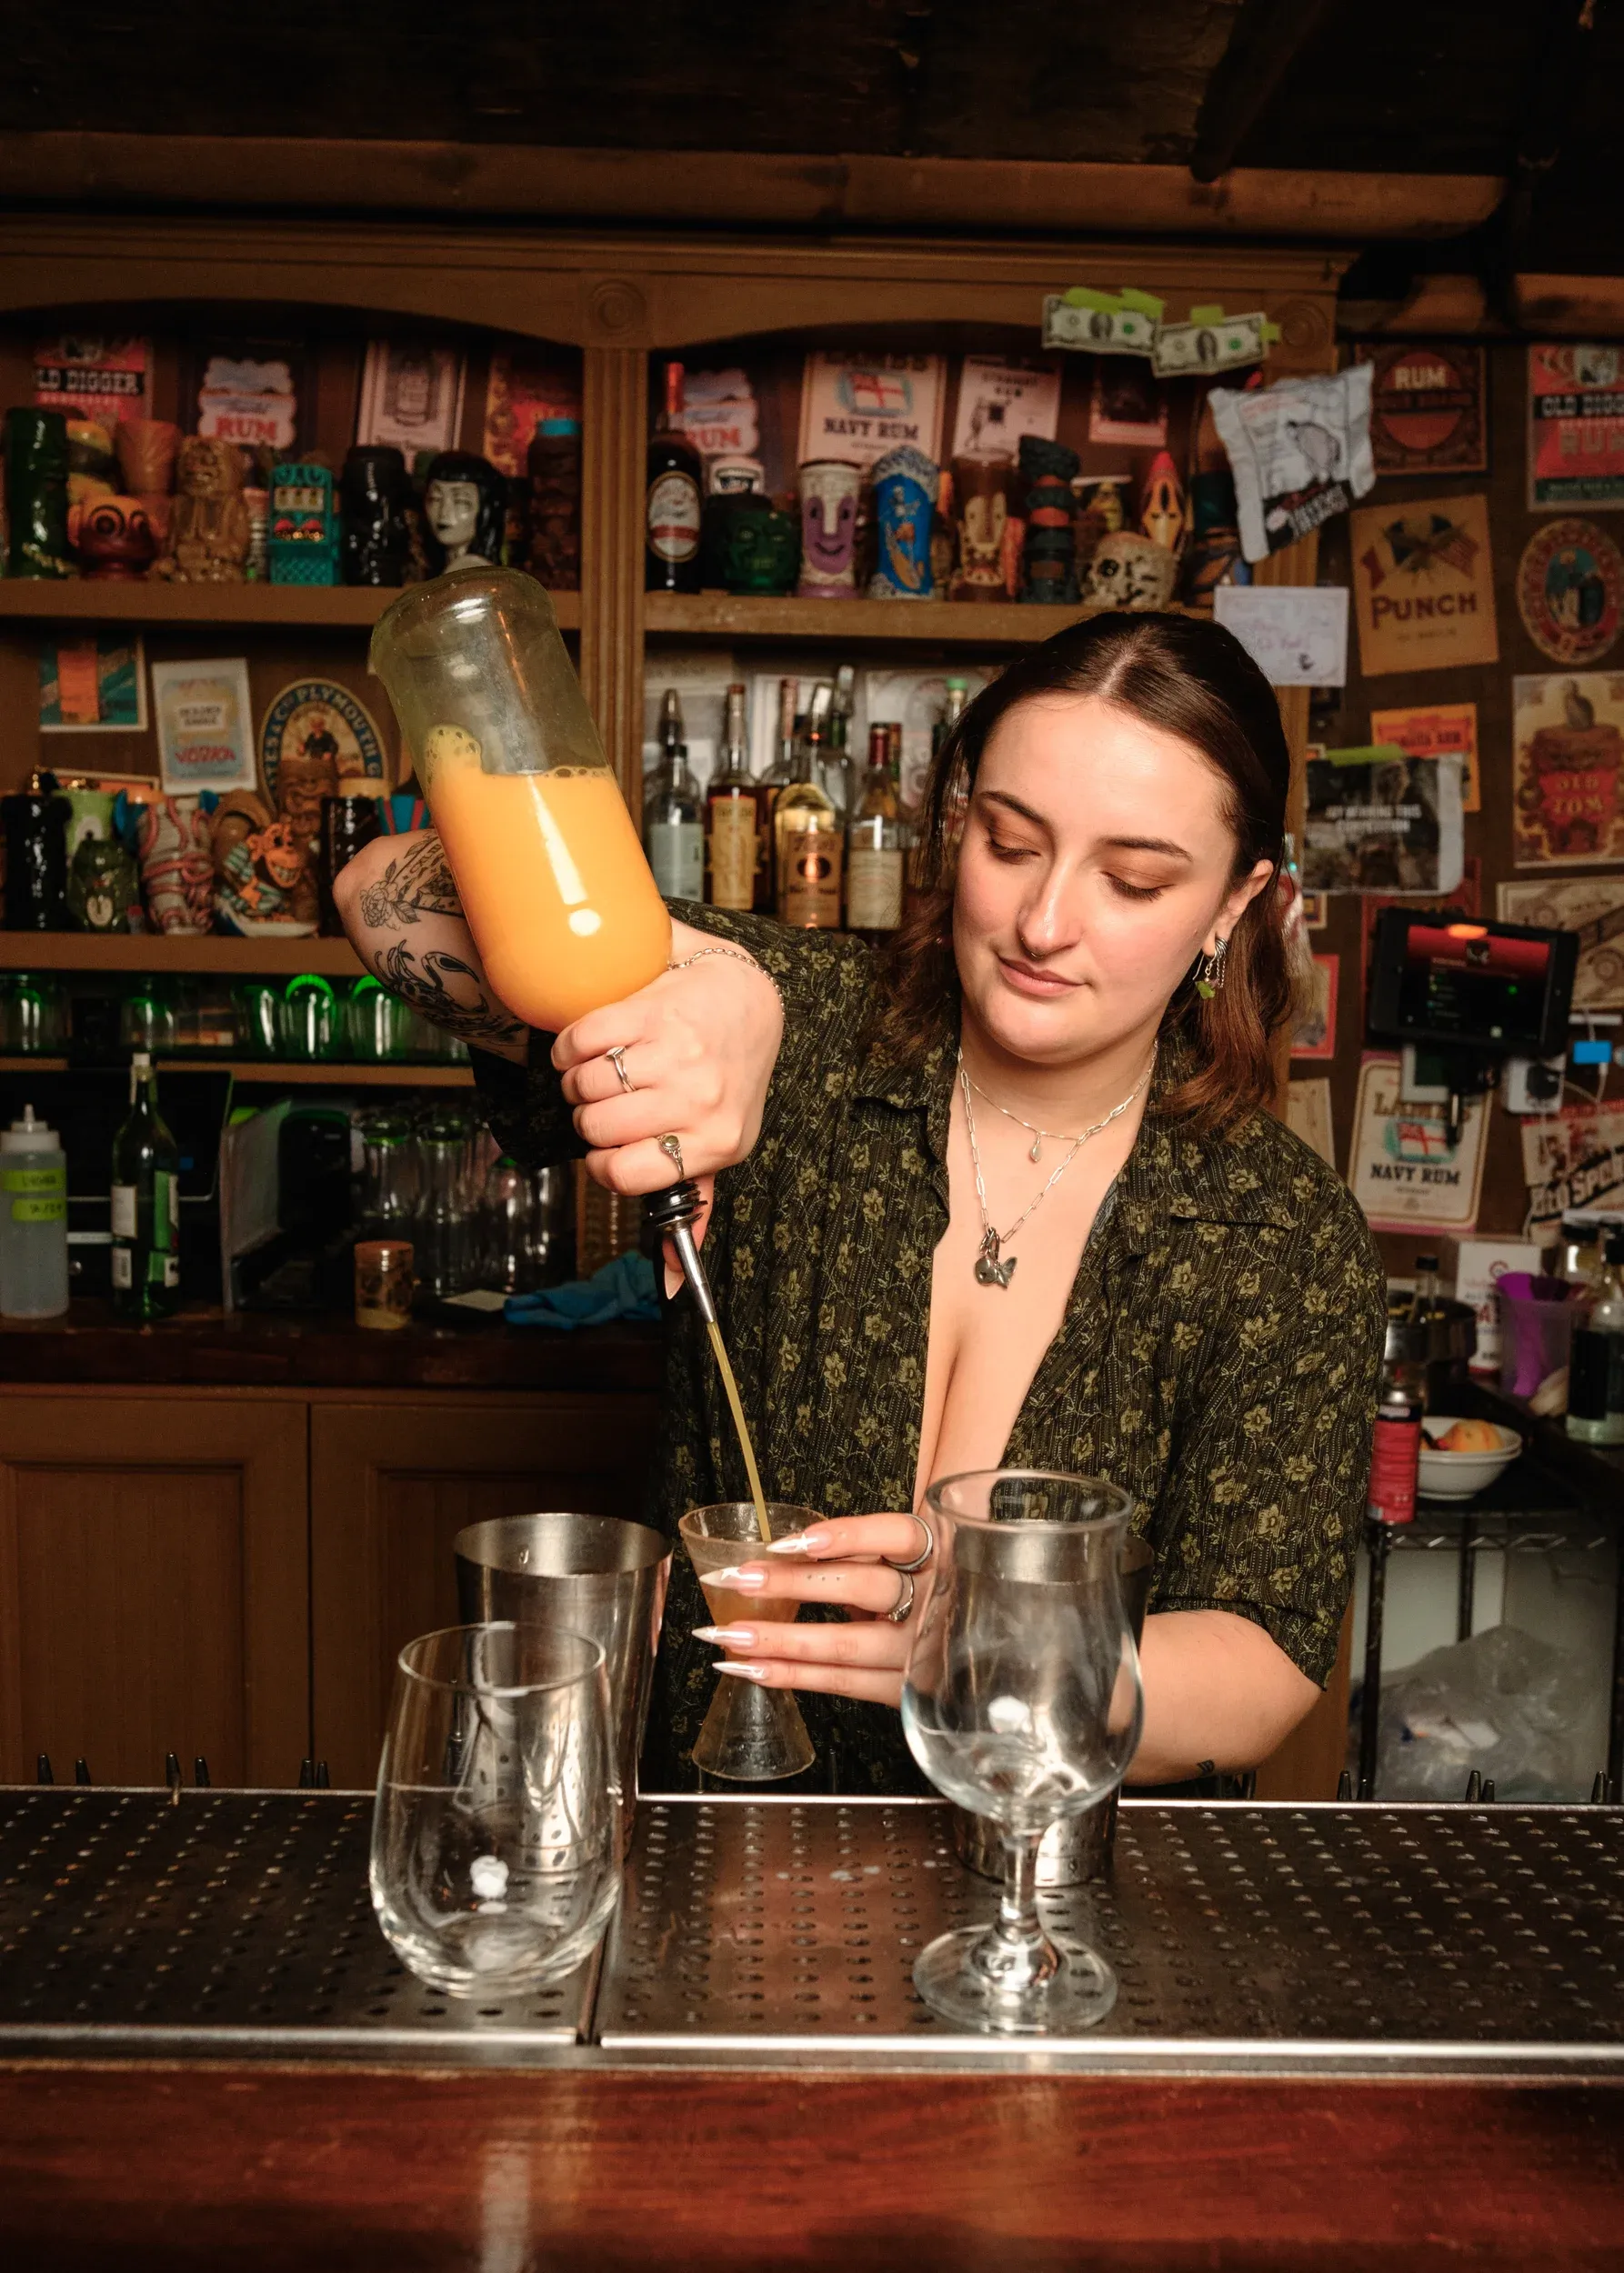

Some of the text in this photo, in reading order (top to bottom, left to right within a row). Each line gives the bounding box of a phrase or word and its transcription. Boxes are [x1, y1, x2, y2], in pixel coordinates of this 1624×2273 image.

[65, 368, 139, 393] DIGGER
[1395, 365, 1447, 389] RUM
[1541, 395, 1578, 416] OLD
[215, 416, 277, 439] RUM
[685, 425, 741, 447] RUM
[824, 416, 918, 441] NAVY RUM
[1371, 592, 1478, 629] PUNCH
[296, 685, 378, 758] PLYMOUTH
[1557, 775, 1599, 794] OLD
[1553, 796, 1603, 816] TOM
[1369, 1162, 1460, 1187] NAVY RUM
